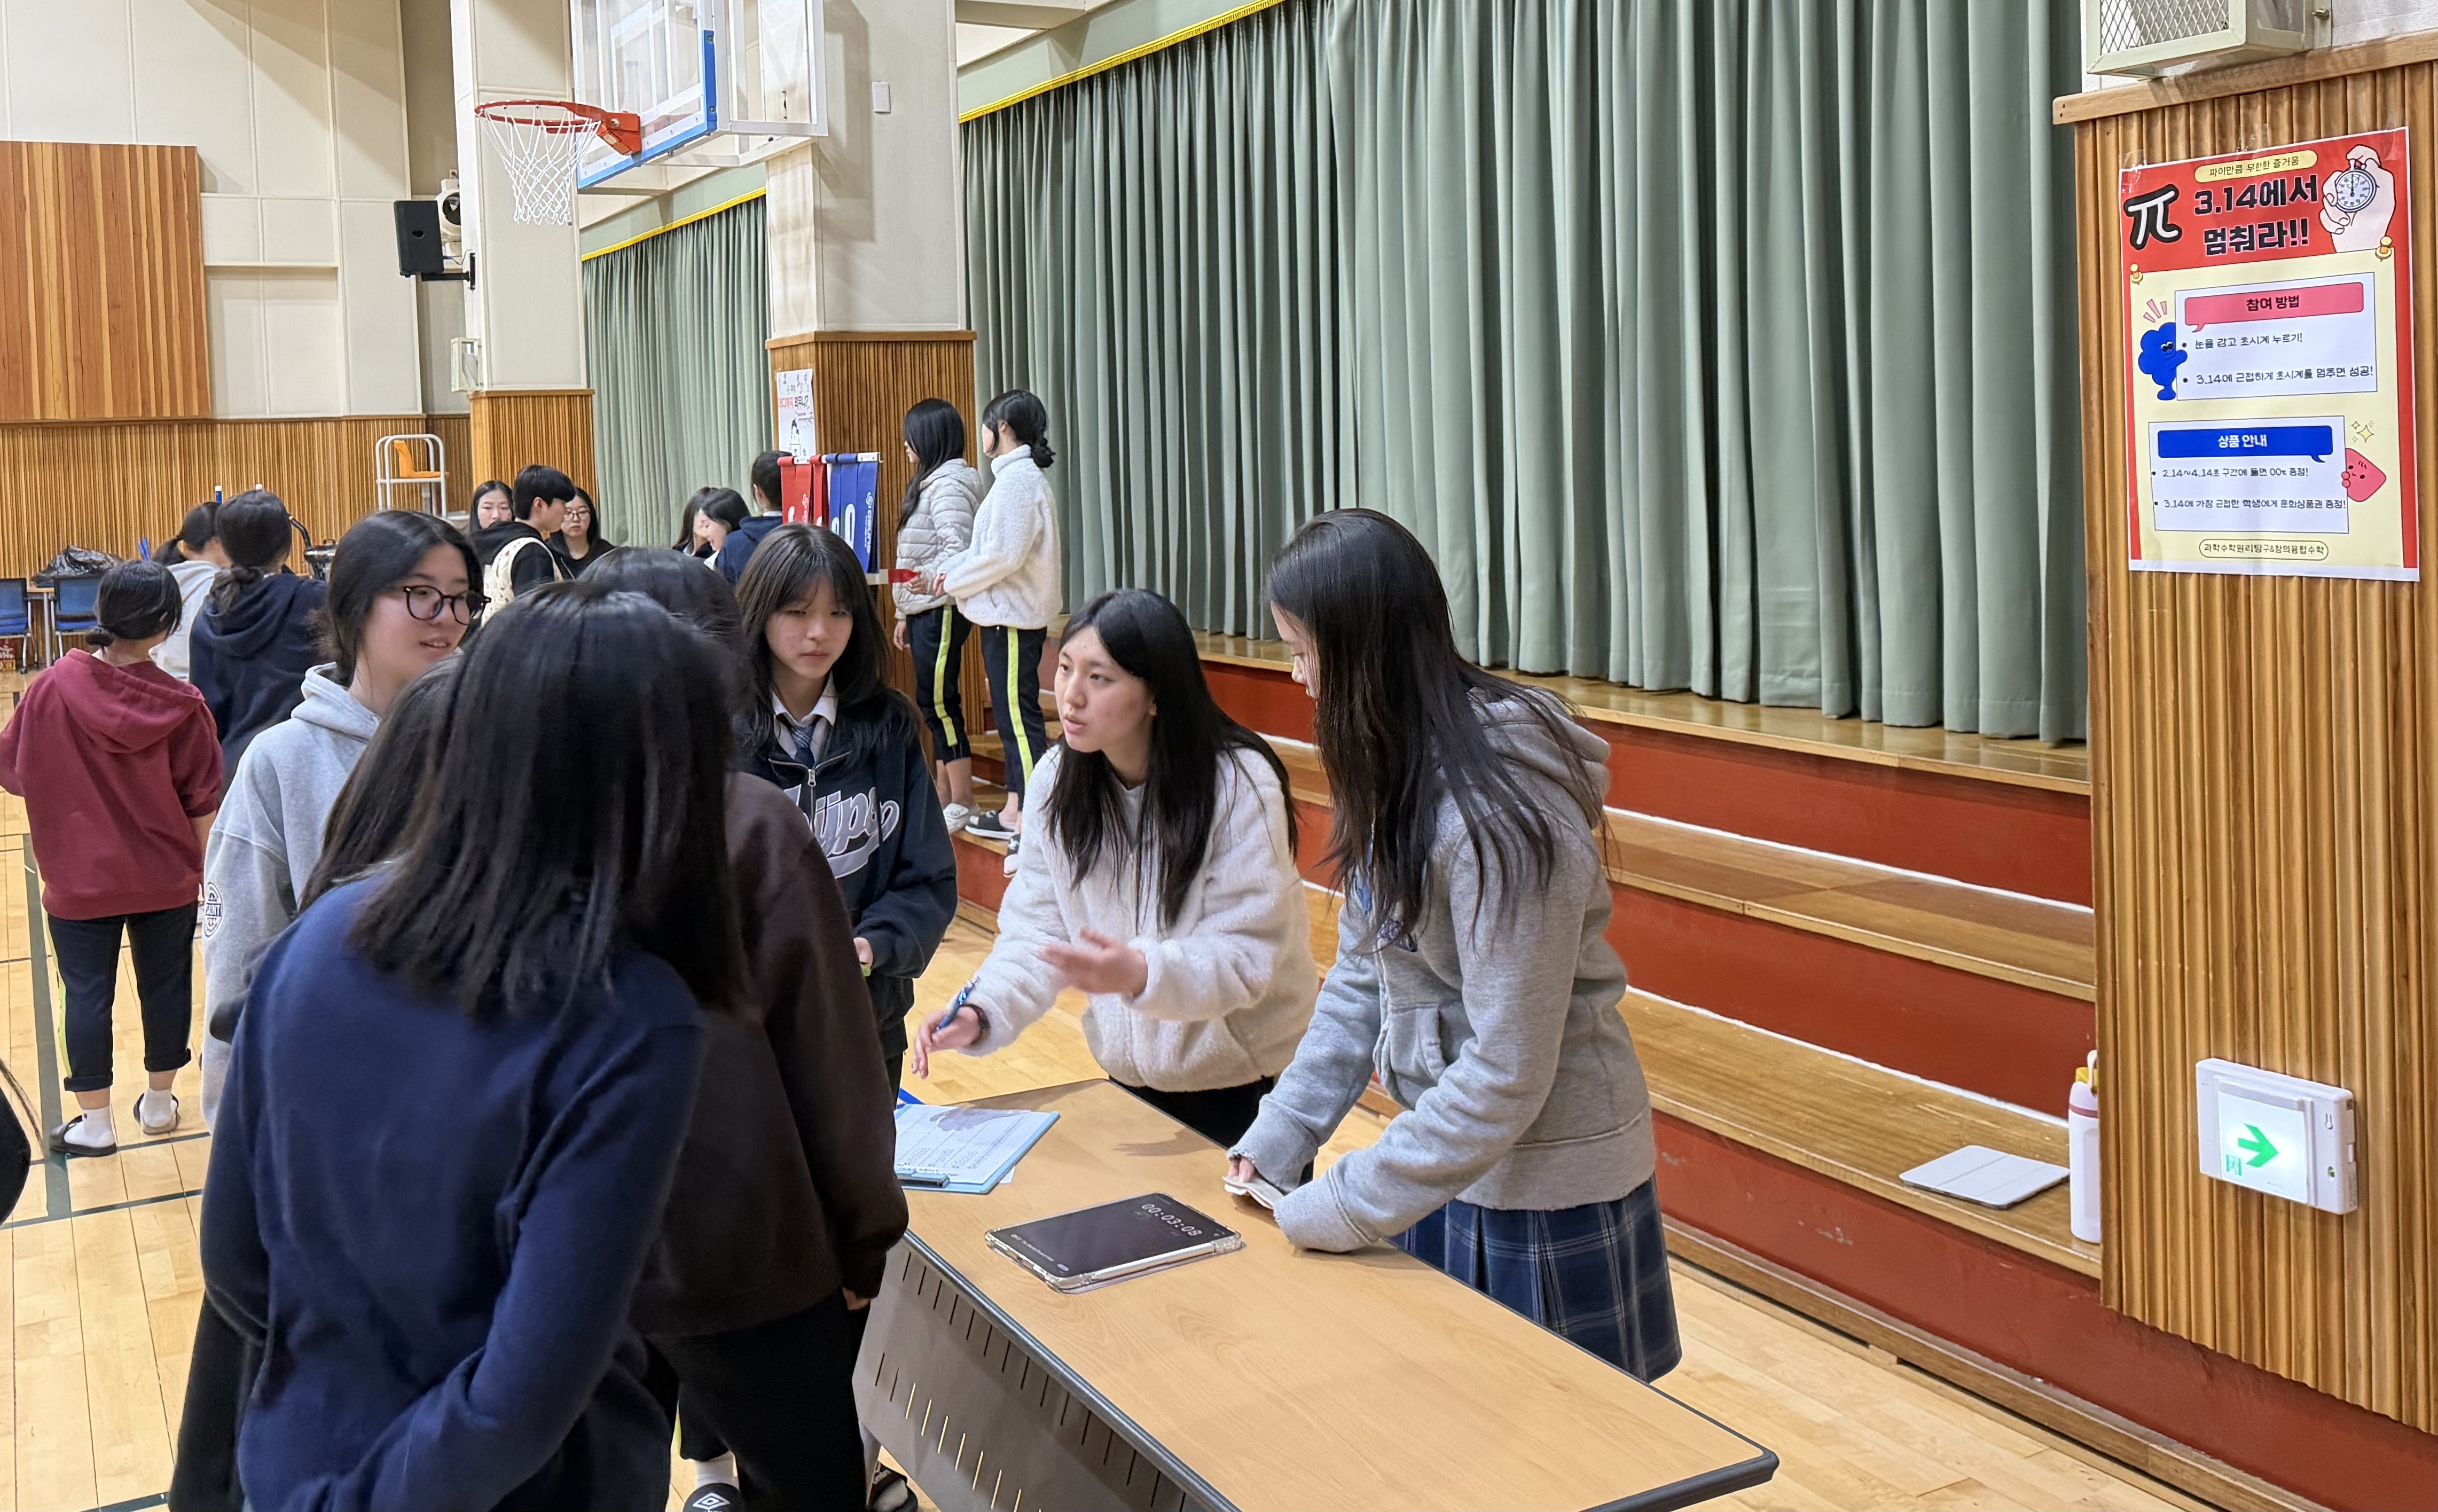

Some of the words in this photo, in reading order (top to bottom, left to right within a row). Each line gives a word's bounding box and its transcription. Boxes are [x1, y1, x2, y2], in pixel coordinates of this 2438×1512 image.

[2209, 164, 2243, 177] 파이만큼
[2246, 160, 2270, 172] 무한한
[2273, 156, 2299, 168] 즐거움
[2194, 175, 2317, 215] 3.14에서
[2205, 218, 2309, 256] 멈춰라!!
[2246, 297, 2272, 311] 참여
[2276, 295, 2300, 309] 방법
[2195, 339, 2214, 349] 눈을
[2217, 338, 2237, 348] 감고
[2272, 333, 2302, 343] 누르기!
[2196, 374, 2232, 385] 3.14에
[2236, 371, 2273, 382] 근접하게
[2317, 367, 2346, 378] 멈추면
[2350, 366, 2373, 377] 성공!
[2218, 435, 2239, 448] 상품
[2242, 434, 2267, 447] 안내
[2222, 468, 2247, 476] 구간에
[2289, 468, 2308, 476] 증정!
[2164, 499, 2194, 508] 3.14에
[2196, 499, 2213, 508] 가장
[2216, 499, 2239, 508] 근접한
[2243, 499, 2278, 508] 학생에게
[2280, 499, 2323, 509] 문화상품권
[2325, 499, 2346, 508] 증정!
[1141, 1203, 1202, 1237] 00:03:08
